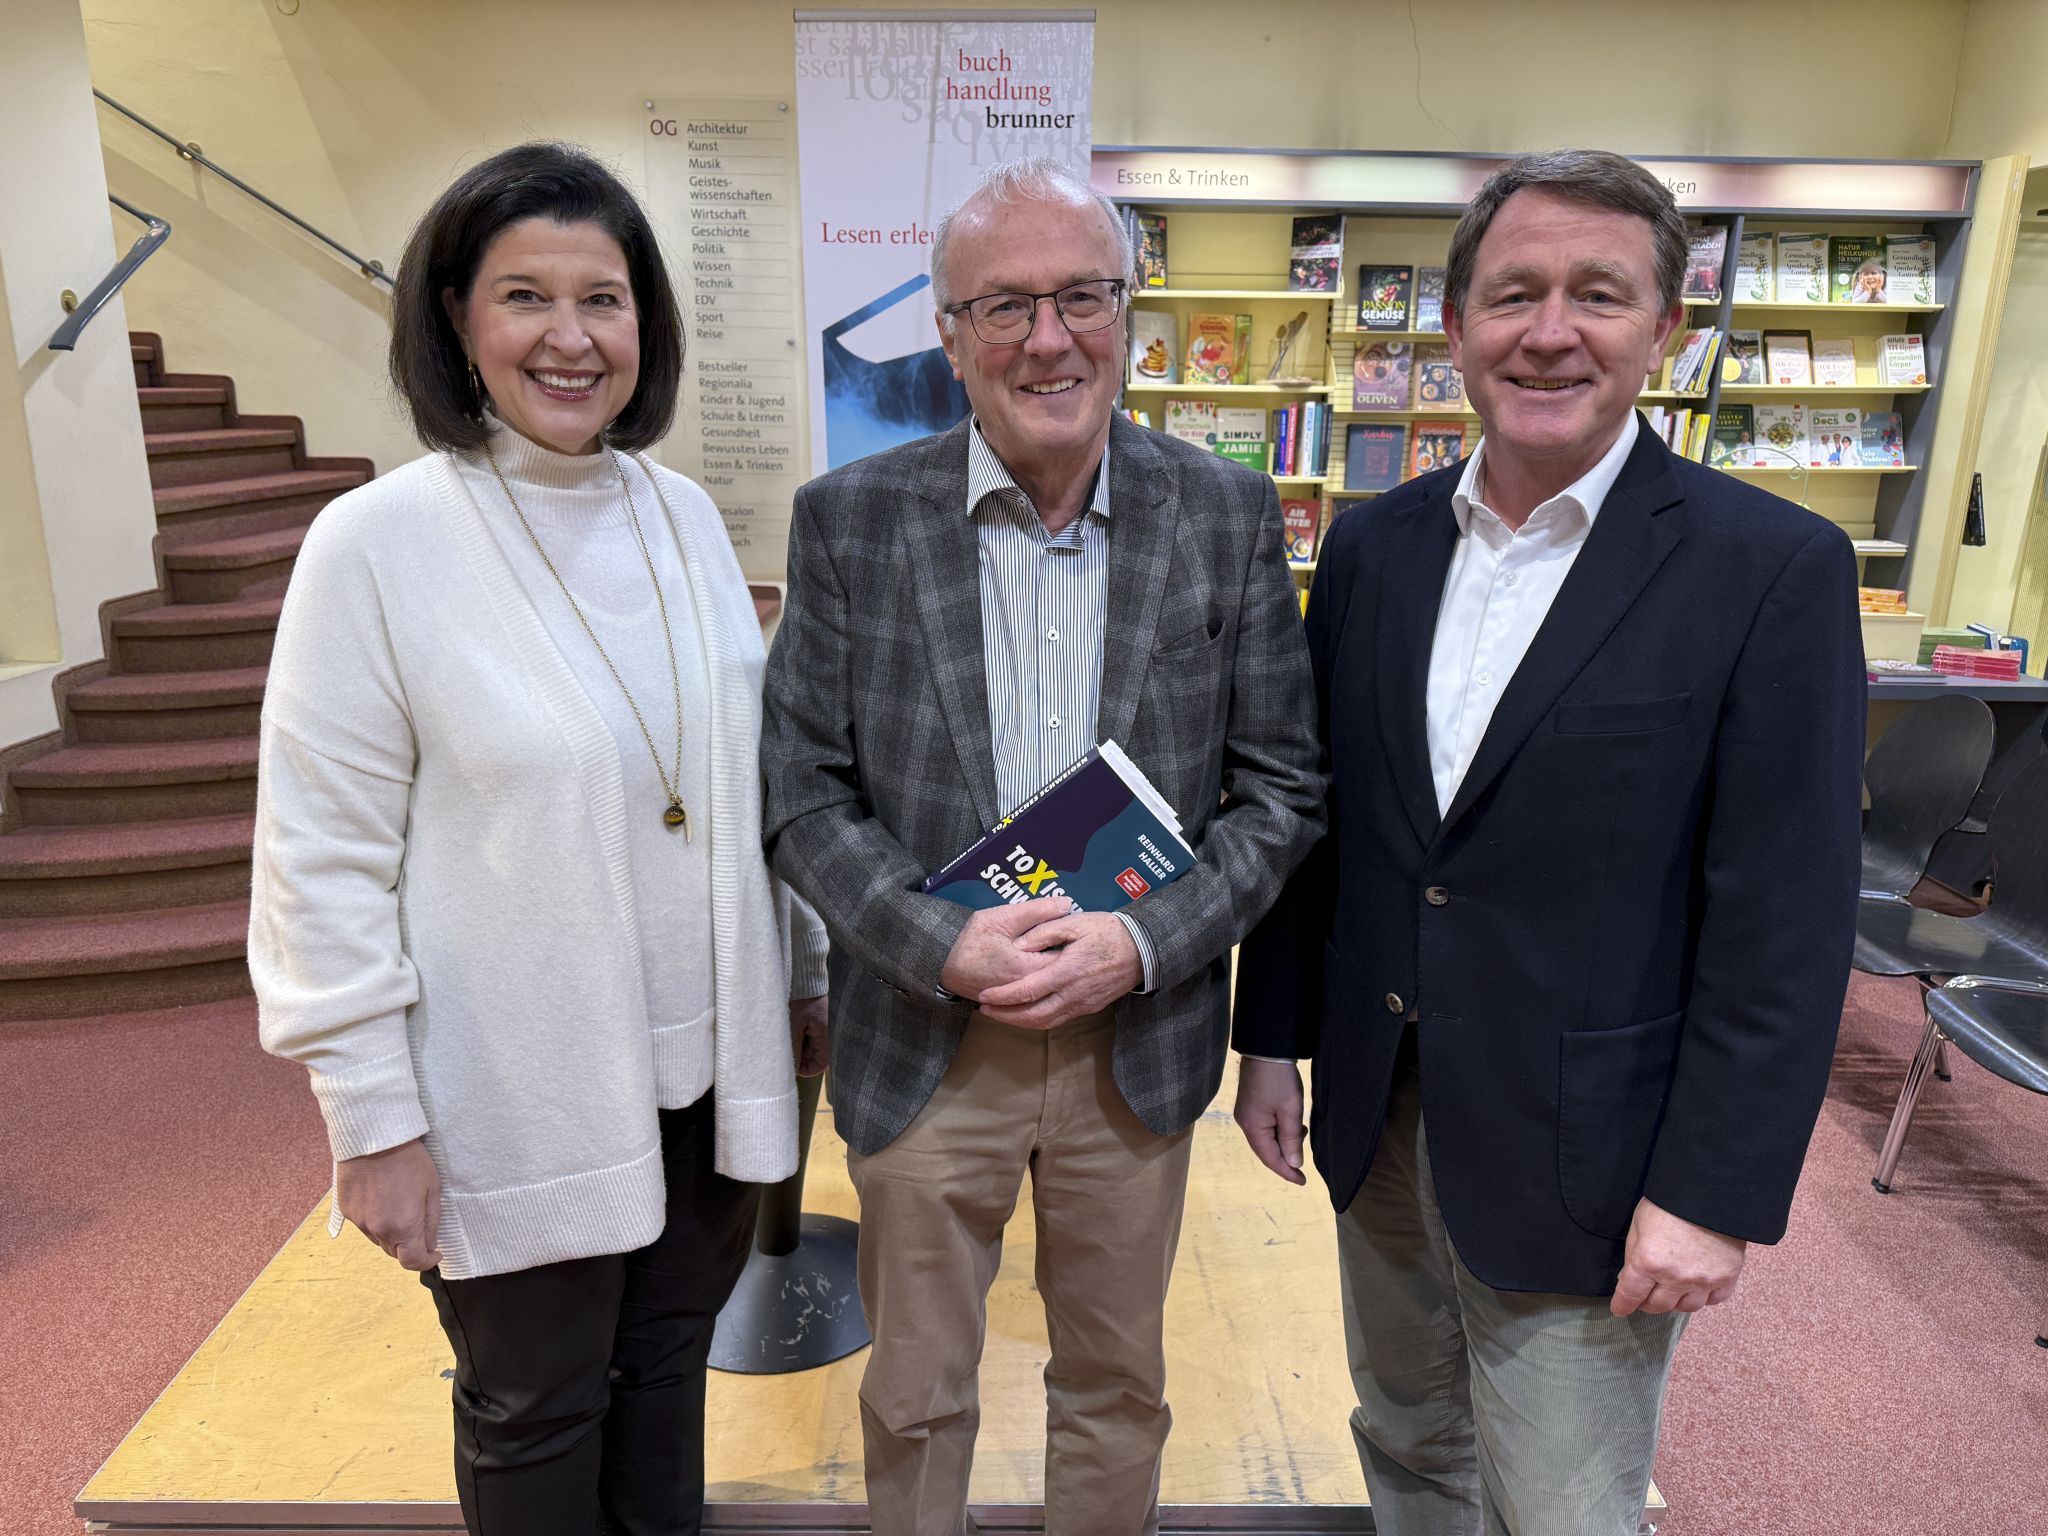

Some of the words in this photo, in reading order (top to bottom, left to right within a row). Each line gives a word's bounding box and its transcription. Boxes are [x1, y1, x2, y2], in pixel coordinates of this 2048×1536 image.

[958, 48, 1012, 72] buch
[946, 77, 1052, 106] handlung
[985, 106, 1075, 129] brunner
[650, 119, 677, 136] OG
[687, 122, 748, 135] Architektur
[687, 140, 719, 151] Kunst
[688, 157, 721, 169] Musik
[689, 175, 733, 188] Geistes-
[1117, 168, 1163, 185] Essen
[1168, 168, 1182, 184] &
[1187, 169, 1250, 187] Trinken
[690, 189, 772, 201] wissenschaften
[690, 208, 748, 220] Wirtschaft
[691, 225, 750, 237] Geschichte
[821, 222, 881, 244] Lesen
[692, 243, 725, 254] Politik
[693, 260, 731, 272] Wissen
[694, 277, 734, 289] Technik
[694, 294, 717, 306] EDV
[1362, 300, 1406, 310] PASSION
[695, 311, 724, 325] Sport
[1362, 307, 1405, 320] GEMÜSE
[696, 329, 723, 340] Reise
[1888, 353, 1922, 362] gesunden
[698, 361, 748, 373] Bestseller
[699, 378, 753, 390] Regionalia
[699, 394, 734, 405] Kinder
[735, 395, 745, 405] &
[748, 396, 785, 409] Jugend
[1356, 394, 1398, 405] OLIVEN
[701, 410, 735, 421] Schule
[737, 411, 746, 421] &
[749, 412, 784, 423] Lernen
[701, 426, 760, 438] Gesundheit
[702, 443, 756, 454] Bewusstes
[758, 444, 789, 455] Leben
[1222, 443, 1262, 453] JAMIE
[703, 459, 732, 470] Essen
[733, 459, 744, 470] &
[746, 460, 783, 471] Trinken
[704, 475, 734, 485] Natur
[991, 795, 1039, 834] TOXISCHES
[1039, 756, 1088, 798] SCHWEIGEN
[940, 851, 967, 874] REINHARD
[966, 836, 987, 853] HALLER
[1137, 834, 1176, 873] REINHARD
[1138, 851, 1167, 880] HALLER
